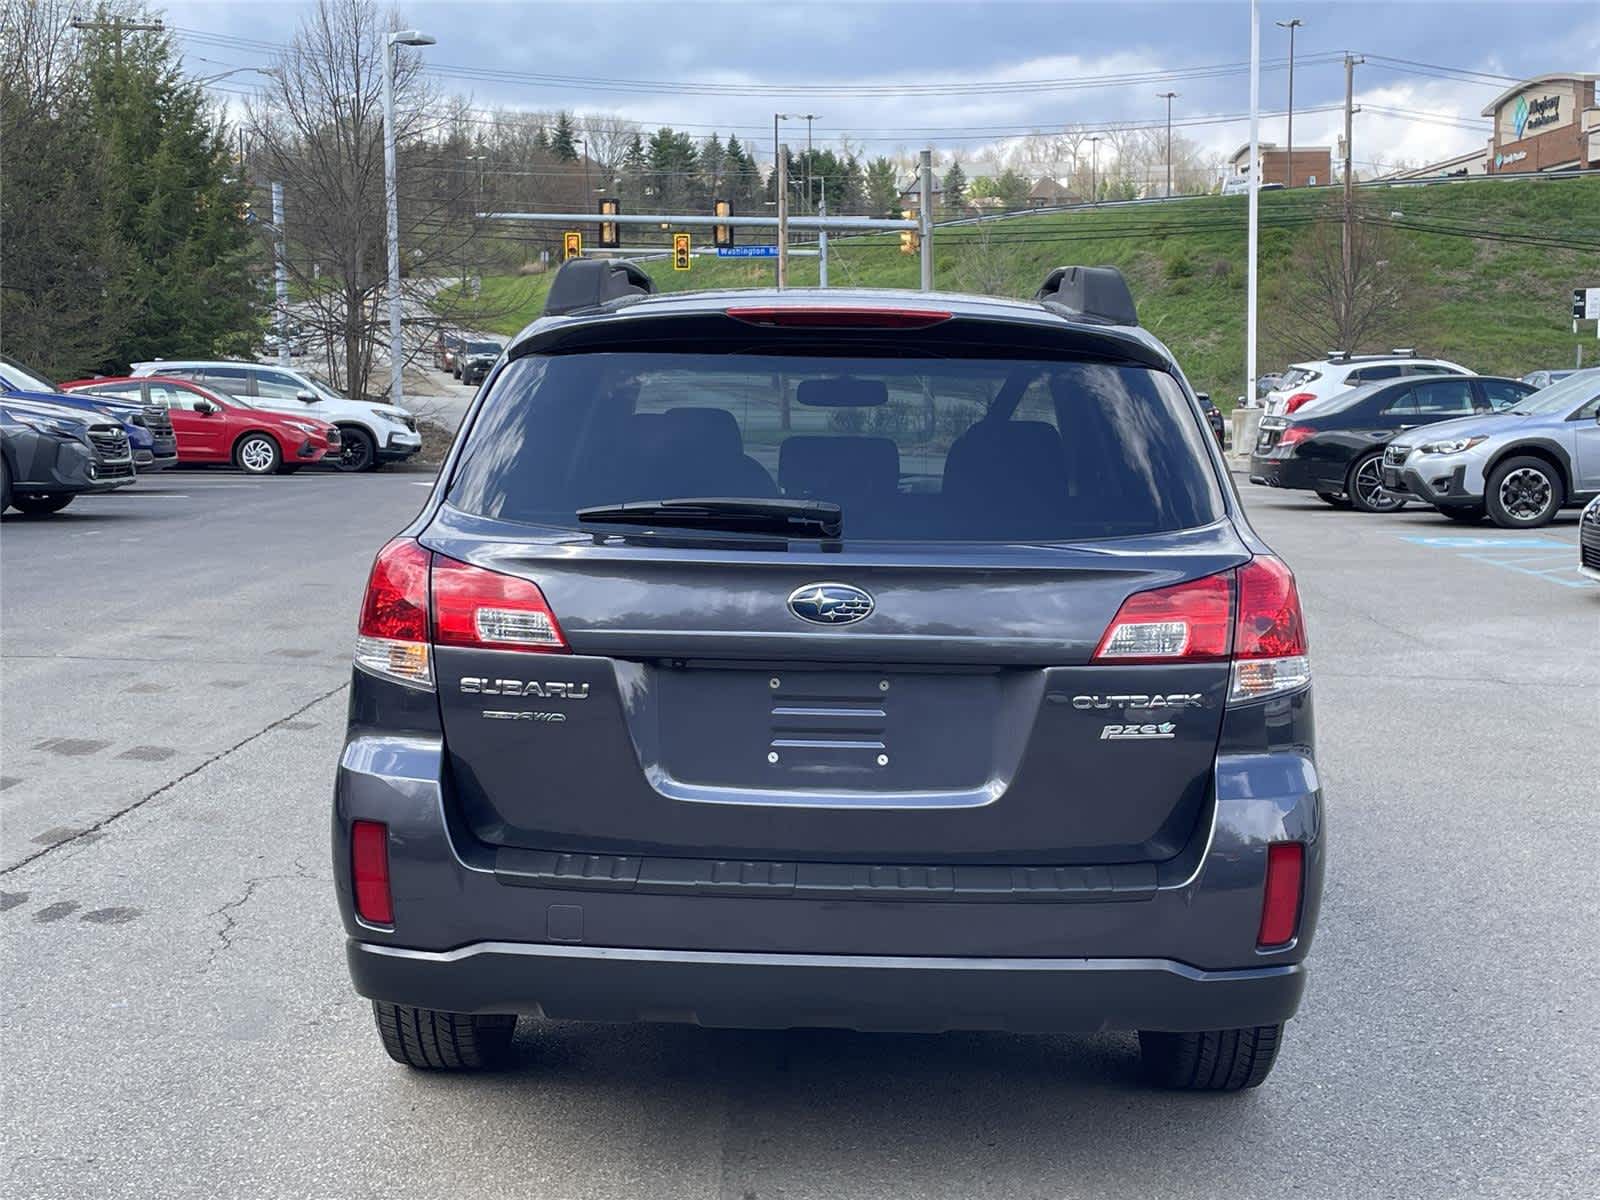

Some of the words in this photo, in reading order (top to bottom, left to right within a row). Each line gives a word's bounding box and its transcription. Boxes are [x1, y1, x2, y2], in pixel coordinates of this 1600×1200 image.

[719, 247, 766, 257] Washington
[460, 677, 589, 699] SUBARU
[1072, 694, 1202, 709] OUTBACK
